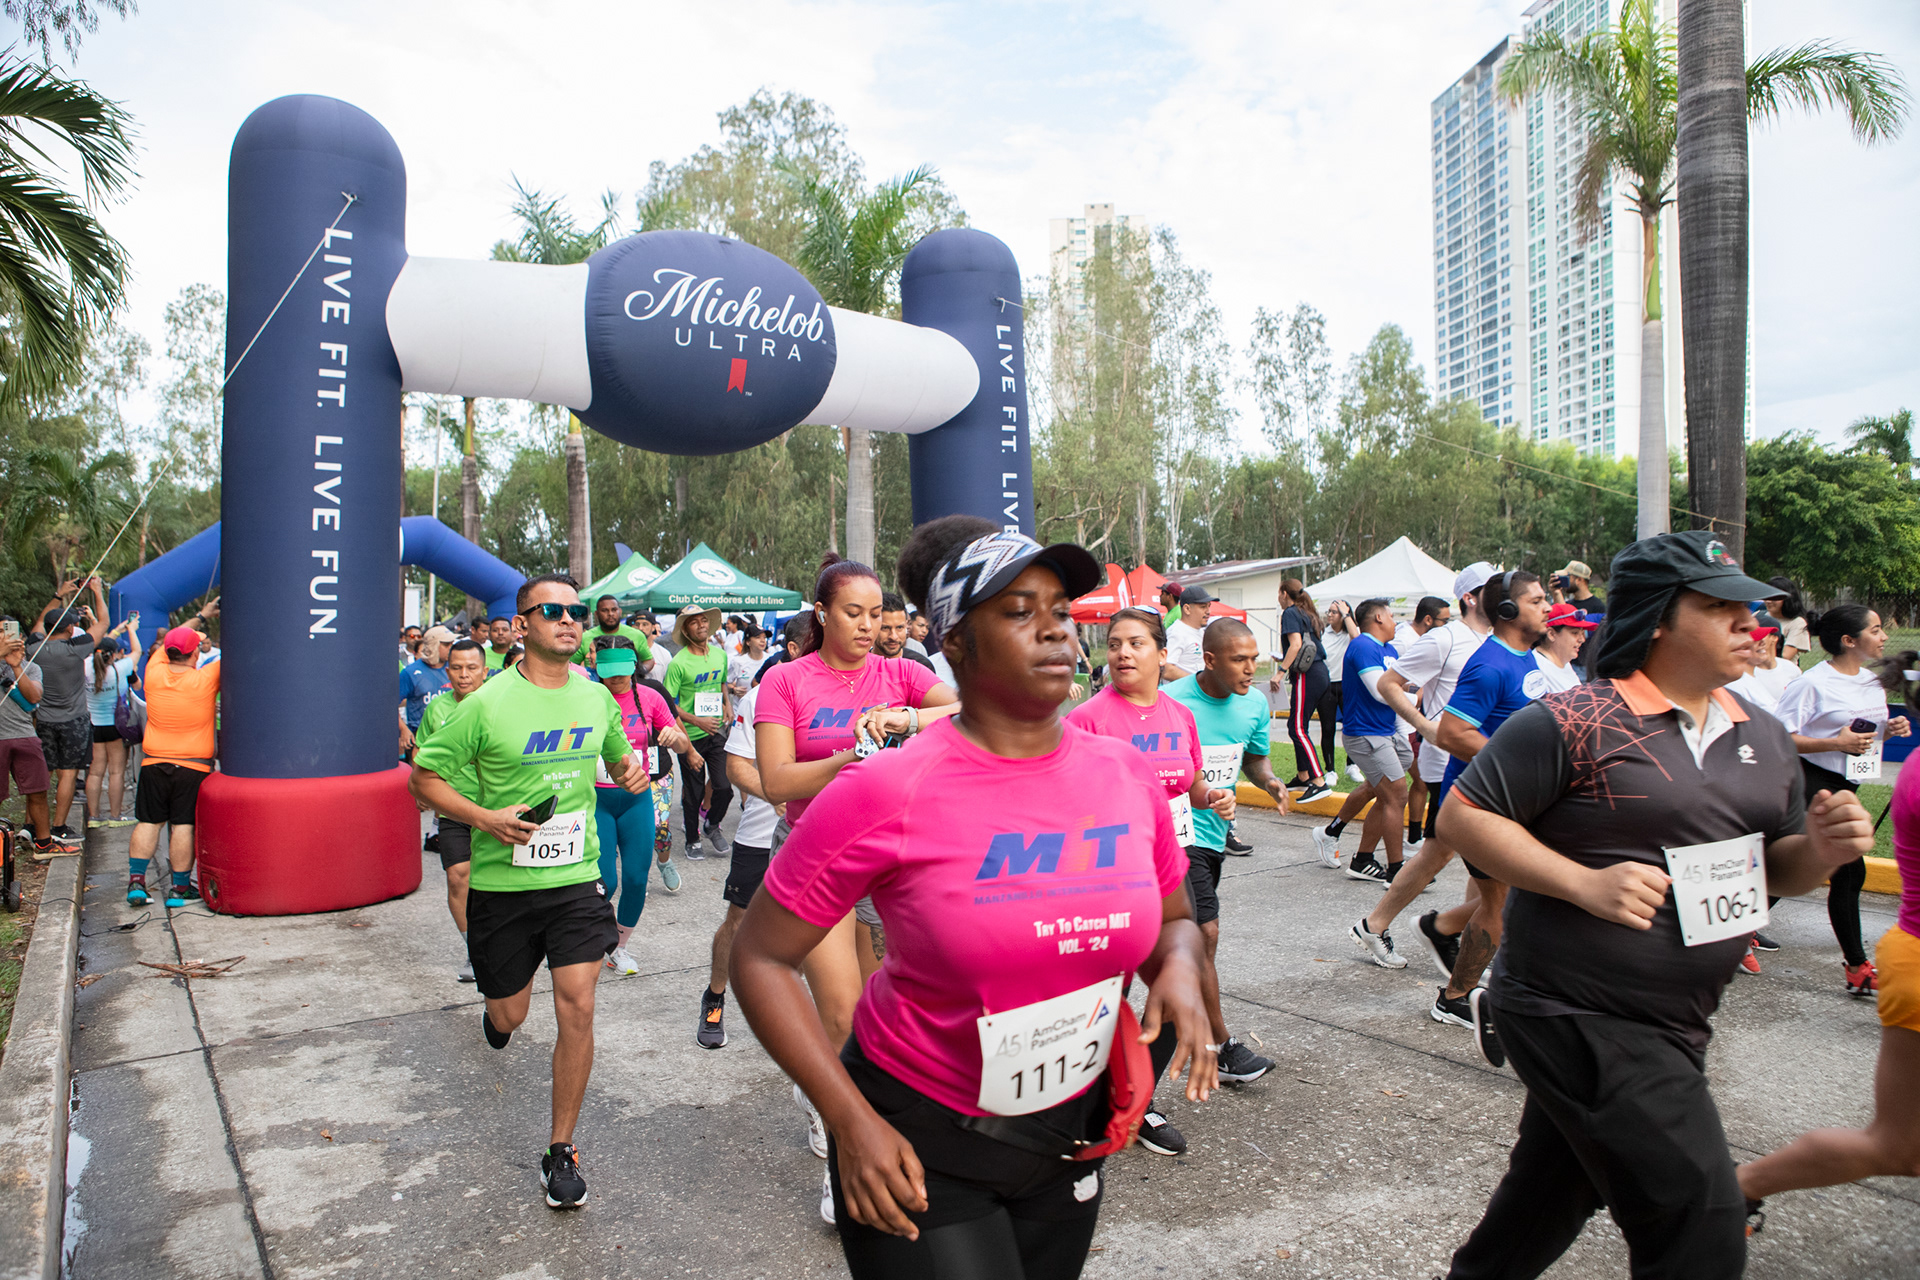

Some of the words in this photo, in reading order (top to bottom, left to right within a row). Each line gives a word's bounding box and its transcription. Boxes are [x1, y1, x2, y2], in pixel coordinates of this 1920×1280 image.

[321, 228, 353, 324] LIVE
[623, 268, 824, 342] Michelob
[675, 327, 802, 362] ULTRA
[996, 325, 1016, 393] LIVE
[317, 342, 348, 408] FIT.
[1001, 406, 1017, 453] FIT.
[312, 435, 343, 531] LIVE
[309, 550, 339, 640] FUN.
[668, 595, 690, 604] Club
[692, 595, 743, 604] Corredores
[744, 596, 759, 604] del
[760, 597, 785, 605] Istmo
[700, 705, 719, 713] 106-3
[521, 759, 549, 767] MANZANILLO
[571, 769, 581, 778] MIT
[1177, 769, 1185, 777] MIT
[1852, 762, 1875, 773] 168-1
[540, 824, 570, 832] AmCham
[528, 841, 575, 860] 105-1
[1680, 863, 1704, 885] 45
[1710, 858, 1746, 872] AmCham
[1710, 869, 1743, 882] Panama
[974, 889, 1043, 906] MANZANILLO
[1046, 883, 1120, 898] INTERNATIONAL
[1699, 887, 1759, 925] 106-2
[1108, 912, 1132, 930] MIT
[1058, 938, 1085, 955] VOL.
[1031, 1012, 1088, 1040] AmCham
[995, 1033, 1023, 1058] 45
[1030, 1026, 1079, 1051] Panama
[1010, 1040, 1099, 1100] 111-2
